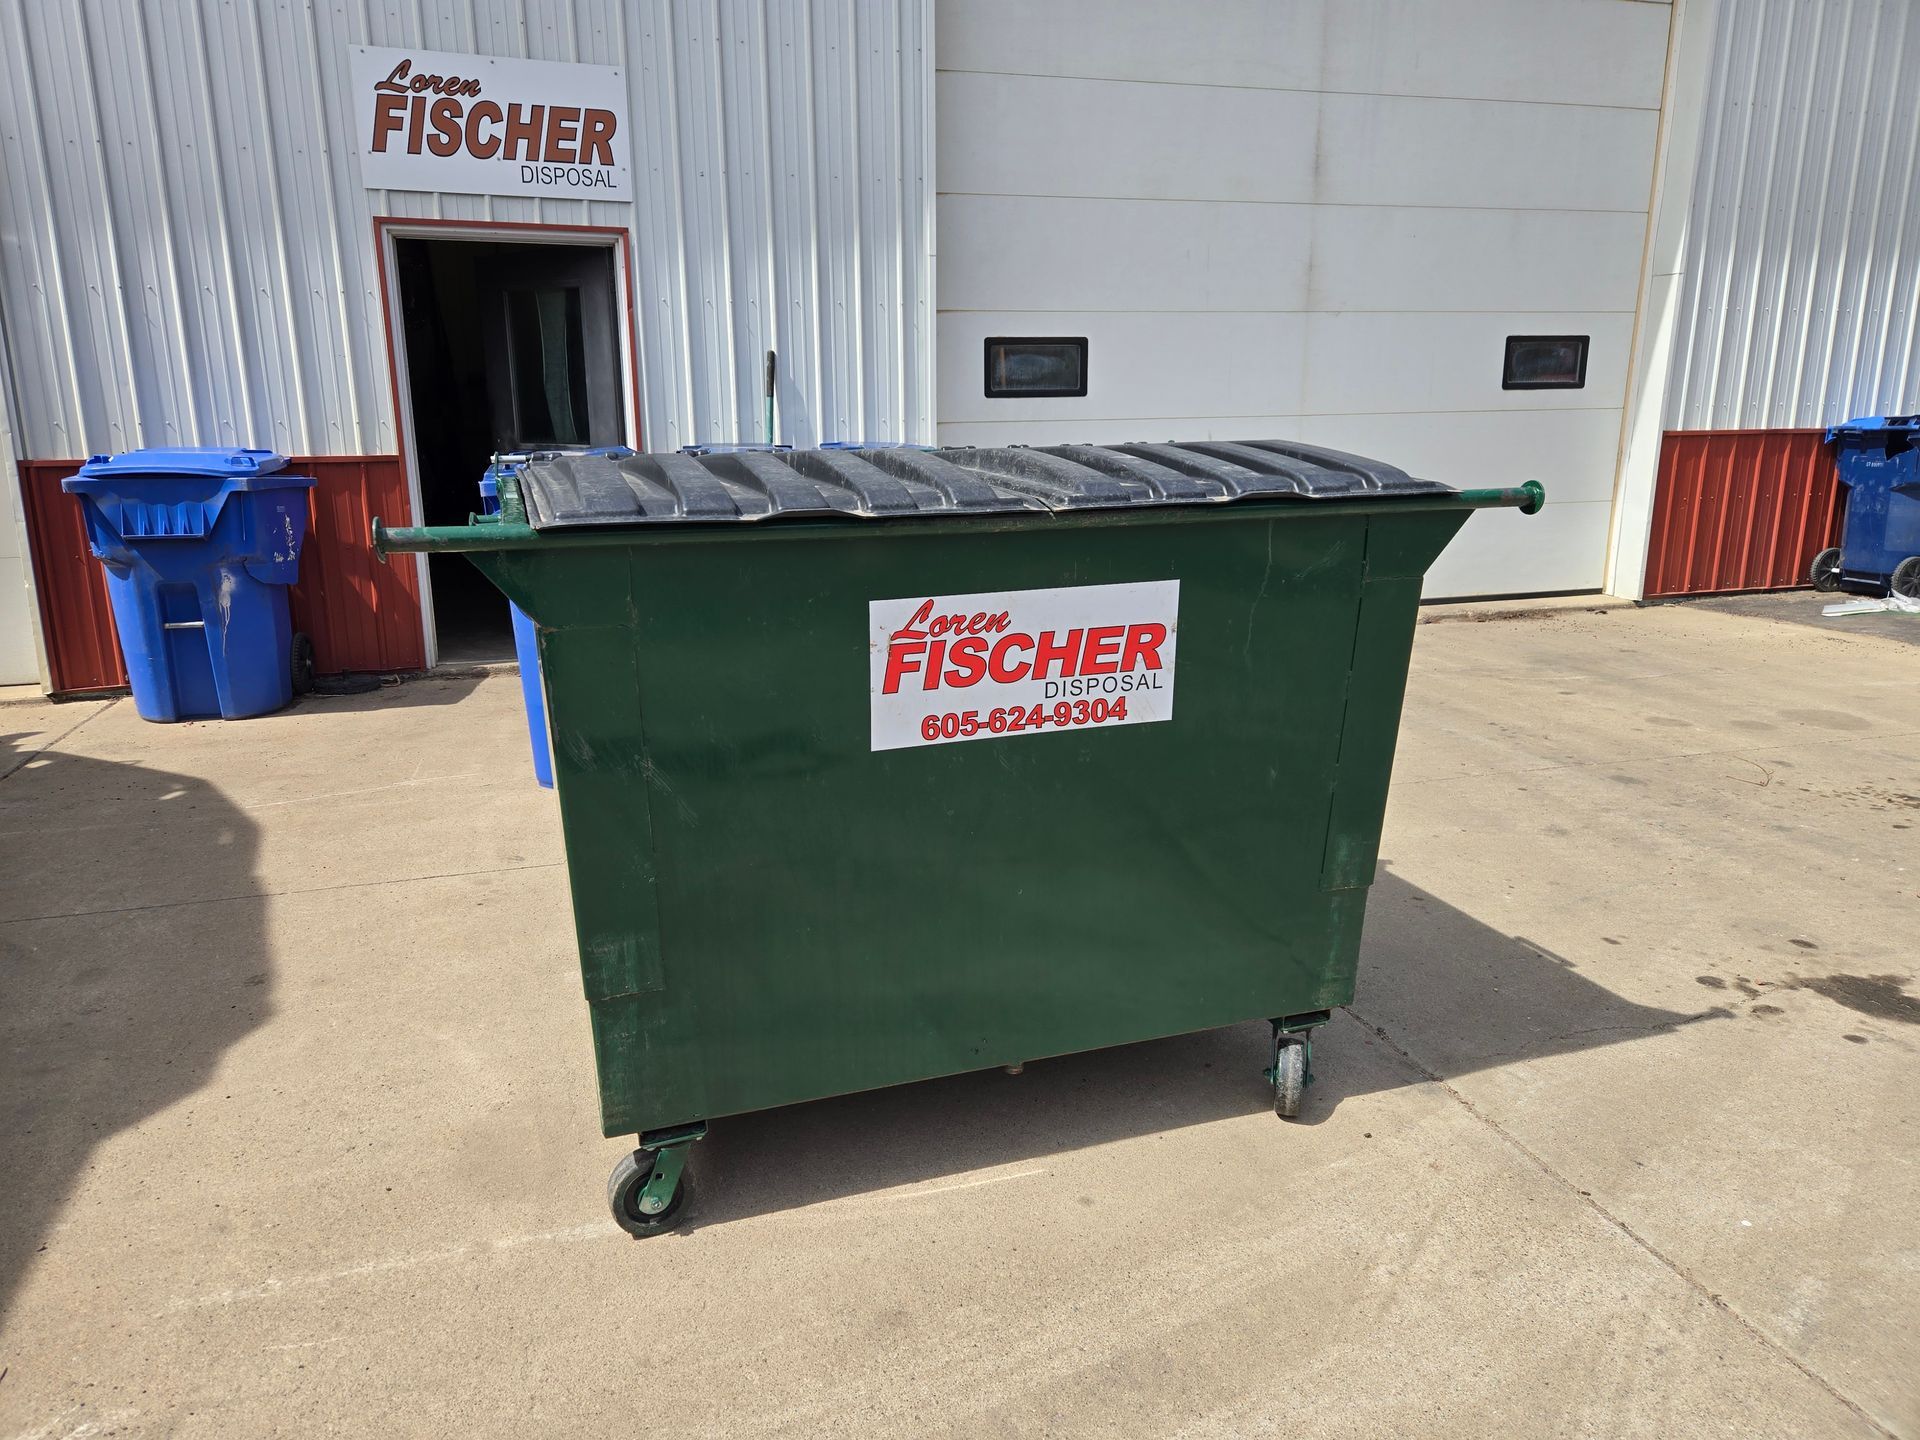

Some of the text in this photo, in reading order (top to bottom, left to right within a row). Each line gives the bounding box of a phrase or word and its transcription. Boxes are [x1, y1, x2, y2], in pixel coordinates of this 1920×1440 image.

[374, 59, 481, 97] Loren
[372, 93, 617, 166] FISCHER
[521, 166, 617, 188] DISPOSAL
[890, 599, 1011, 641] Loren
[882, 623, 1167, 694] FISCHER
[1045, 673, 1163, 698] DISPOSAL
[921, 696, 1127, 741] 605-624-9304
